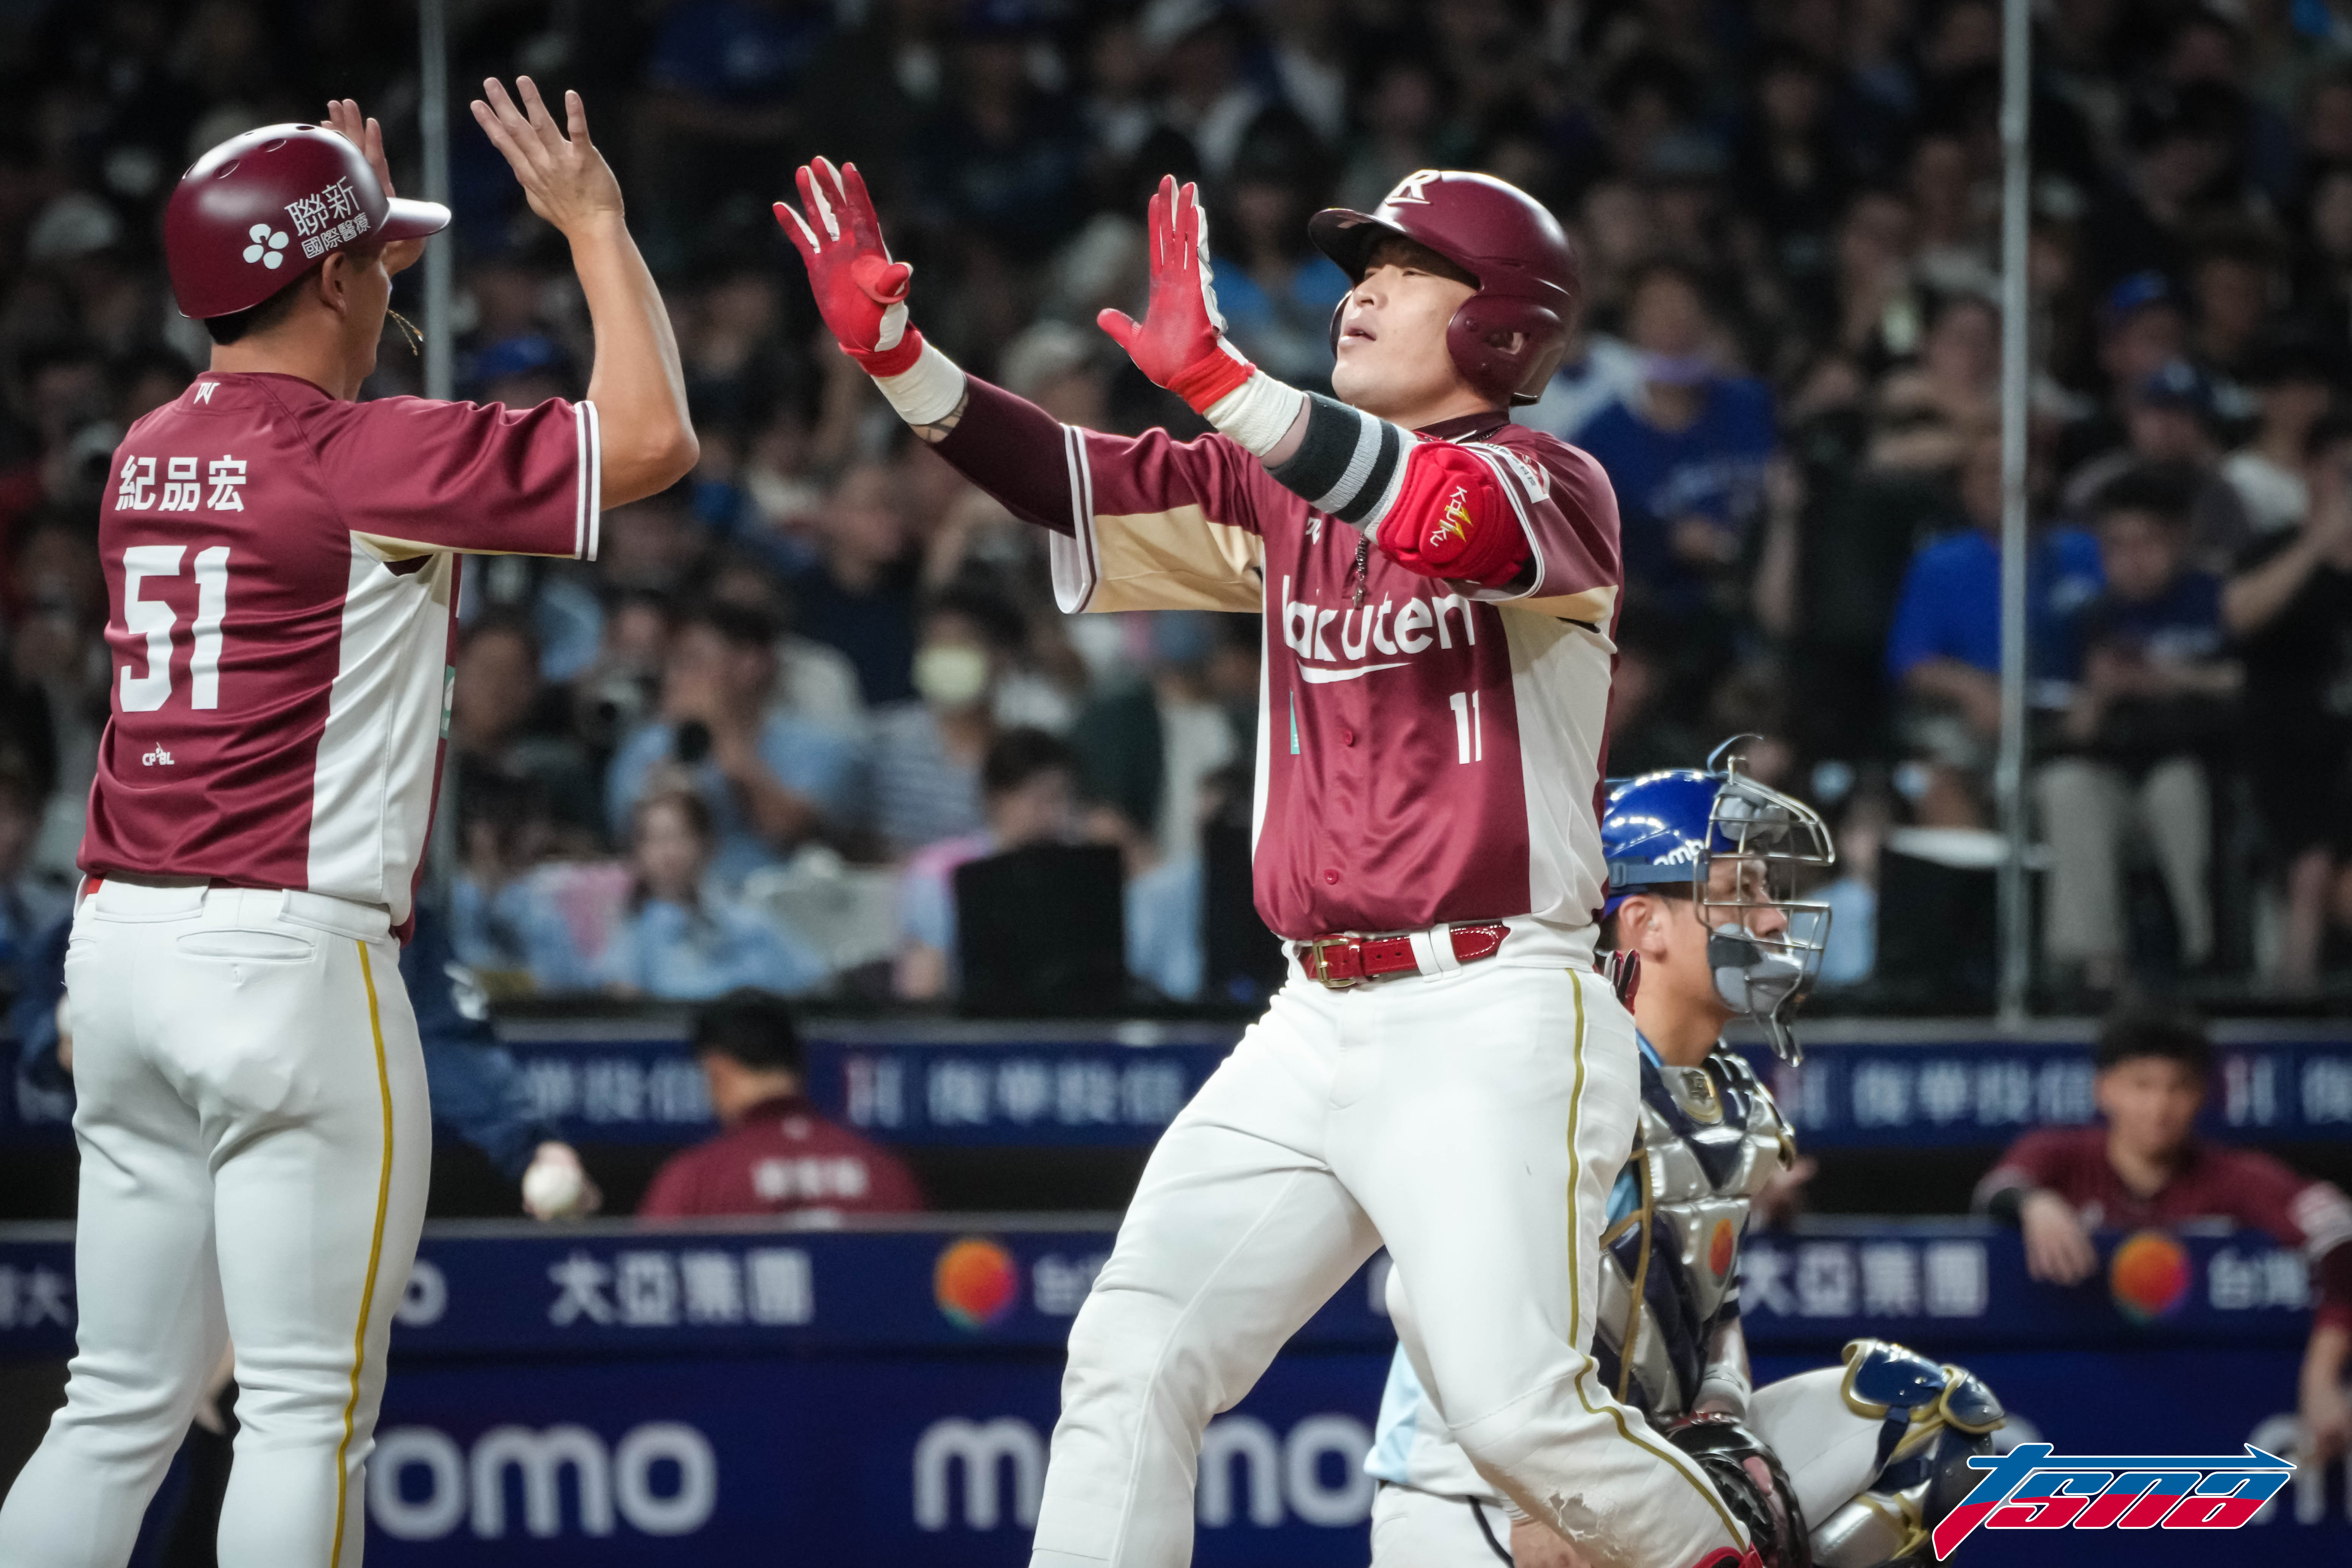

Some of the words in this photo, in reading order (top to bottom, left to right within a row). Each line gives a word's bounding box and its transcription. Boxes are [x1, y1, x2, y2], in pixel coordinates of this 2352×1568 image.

[284, 176, 360, 236] 聯新
[1384, 169, 1442, 204] R
[301, 212, 371, 259] 國際醫療
[115, 455, 247, 512] 紀品宏
[120, 545, 230, 712] 51
[1283, 575, 1475, 662] akuten
[142, 748, 175, 766] CPBL
[1450, 690, 1482, 764] 11
[368, 1423, 718, 1540] omo
[912, 1414, 1379, 1532] mmo
